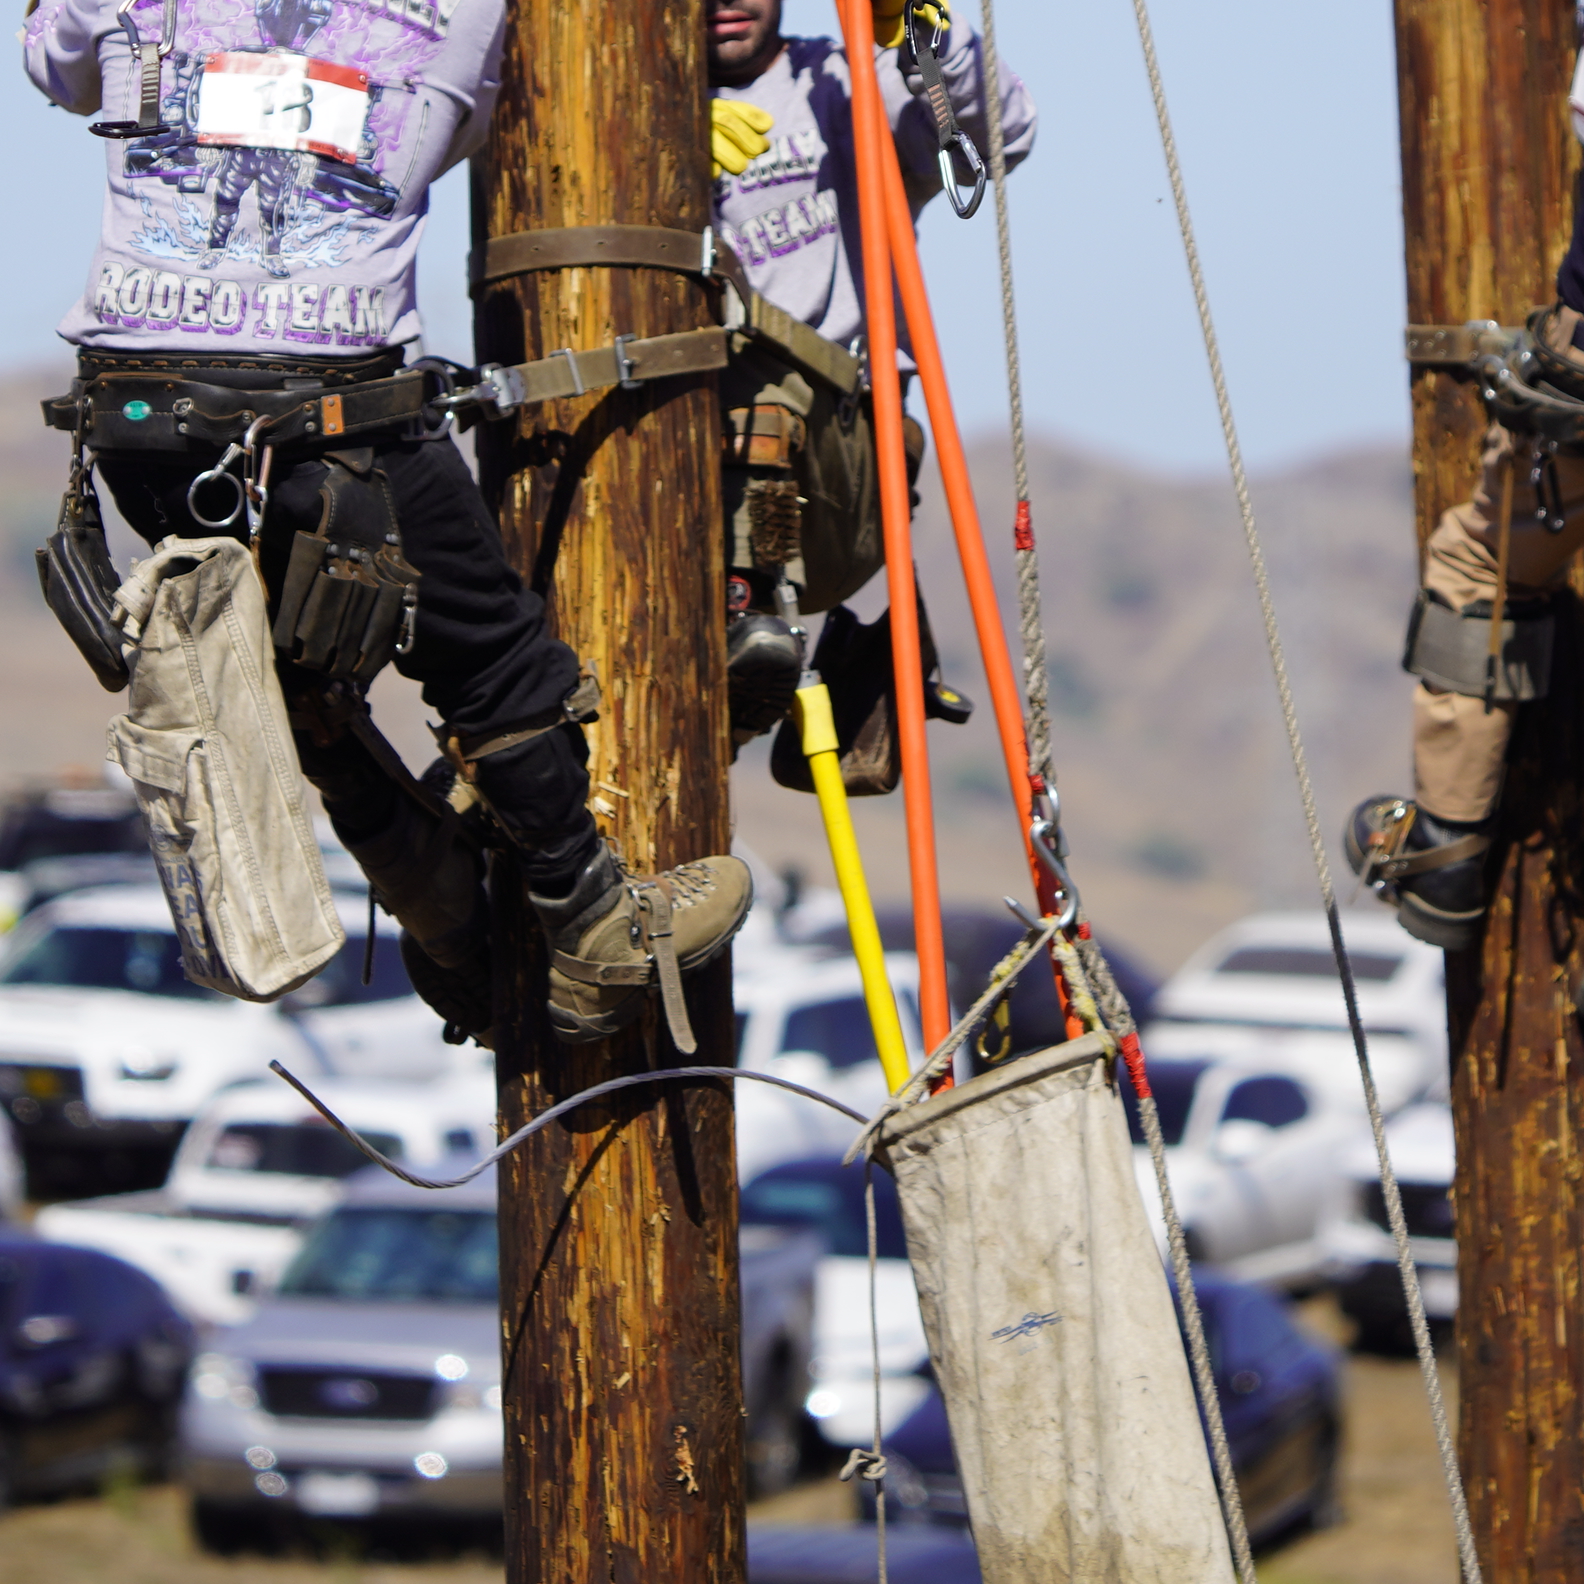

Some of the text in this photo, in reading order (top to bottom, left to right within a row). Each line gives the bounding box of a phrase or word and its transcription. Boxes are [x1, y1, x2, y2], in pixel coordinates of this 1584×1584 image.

[739, 188, 838, 265] TEAM
[94, 260, 389, 343] RODEO TEAM
